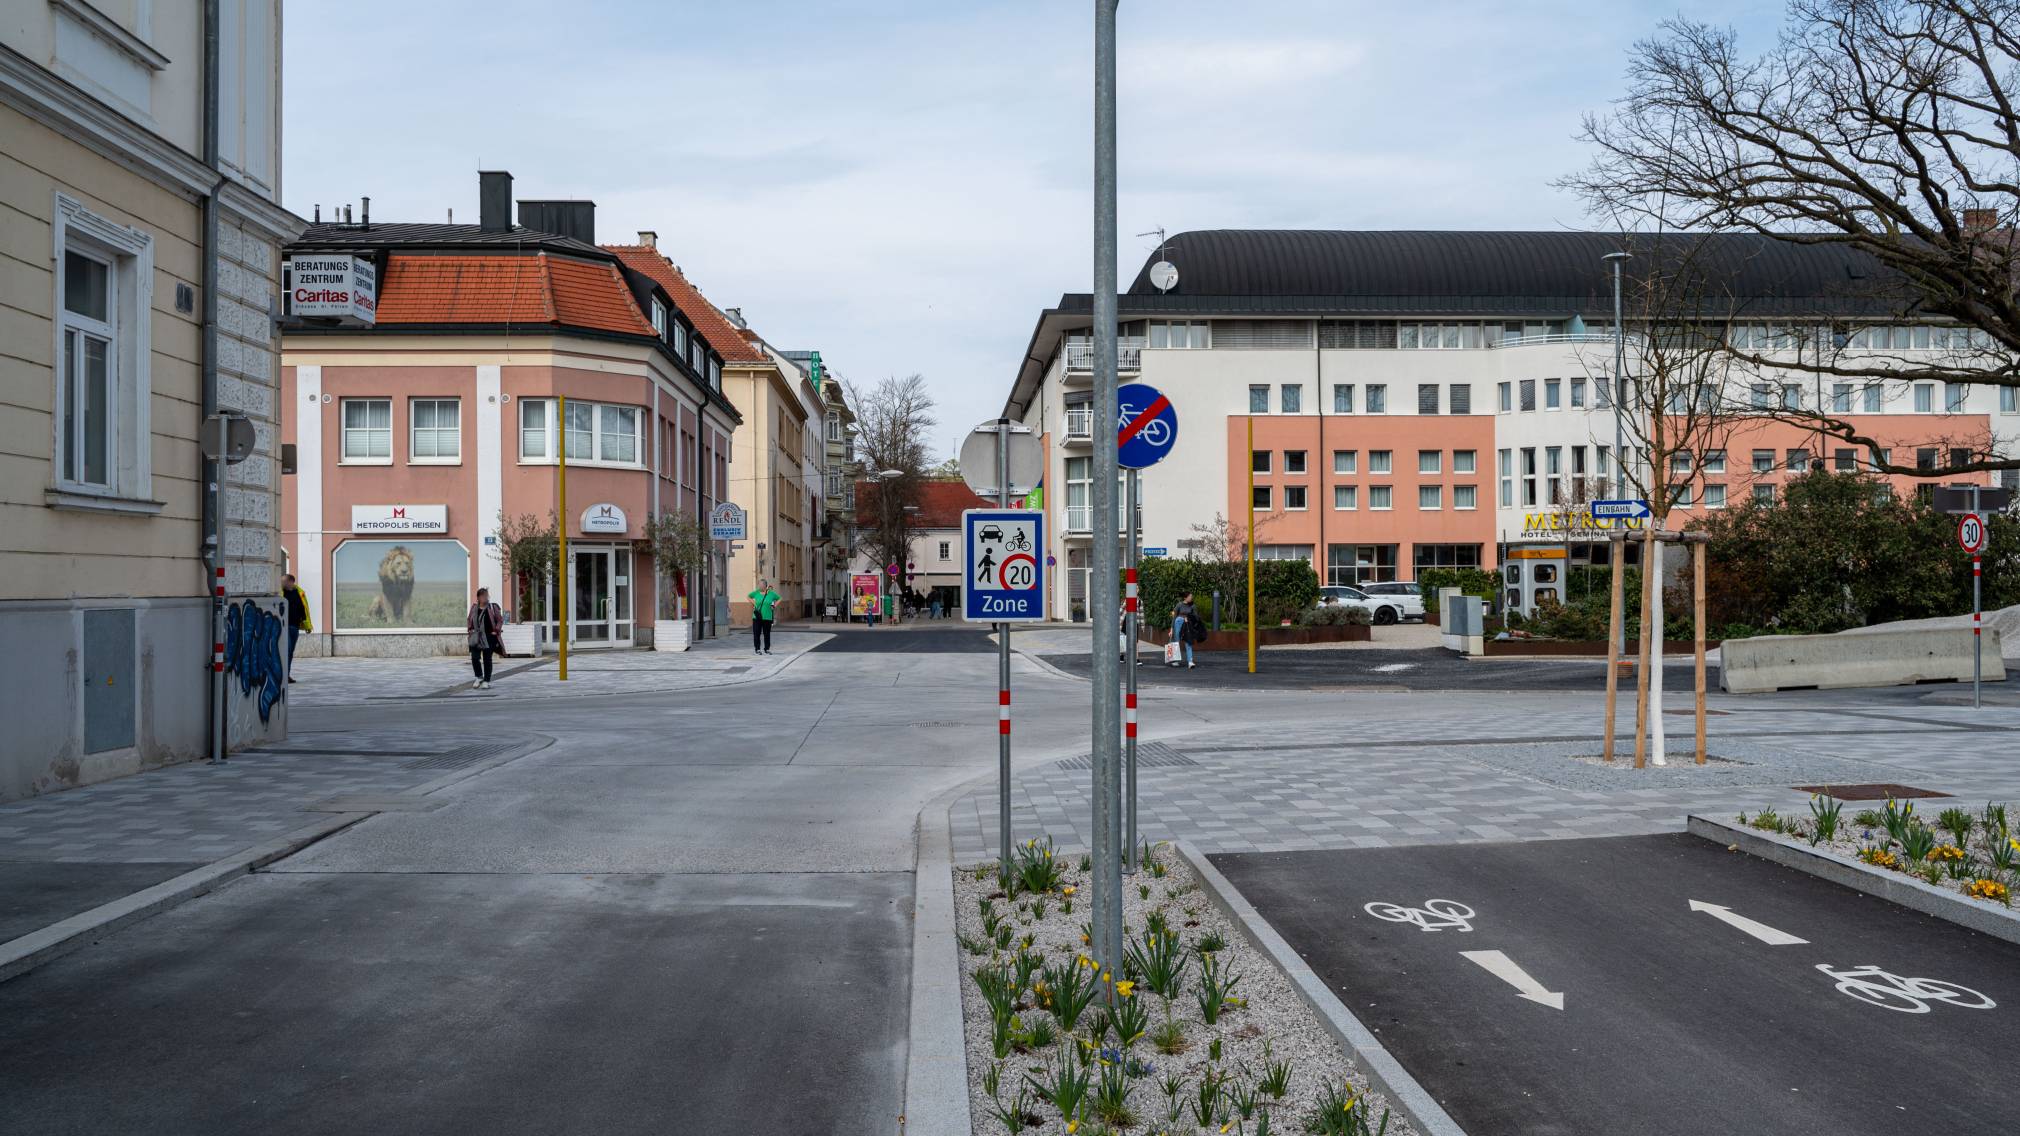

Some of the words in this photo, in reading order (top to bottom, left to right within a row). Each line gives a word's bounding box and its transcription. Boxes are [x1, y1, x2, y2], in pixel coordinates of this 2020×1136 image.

[294, 261, 349, 271] BERATUNGS
[353, 263, 374, 280] BERATUNGS
[300, 274, 344, 284] ZENTRUM
[355, 276, 373, 291] ZENTRUM
[295, 288, 349, 303] Caritas
[353, 290, 374, 311] Caritas
[393, 507, 405, 518] M
[600, 506, 612, 518] M
[1598, 505, 1631, 513] EINBAHN
[356, 521, 410, 529] METROPOLIS
[412, 521, 441, 529] REISEN
[1524, 511, 1649, 530] METROO
[1964, 522, 1978, 544] 30
[1009, 565, 1031, 585] 20
[982, 595, 1028, 612] Zone
